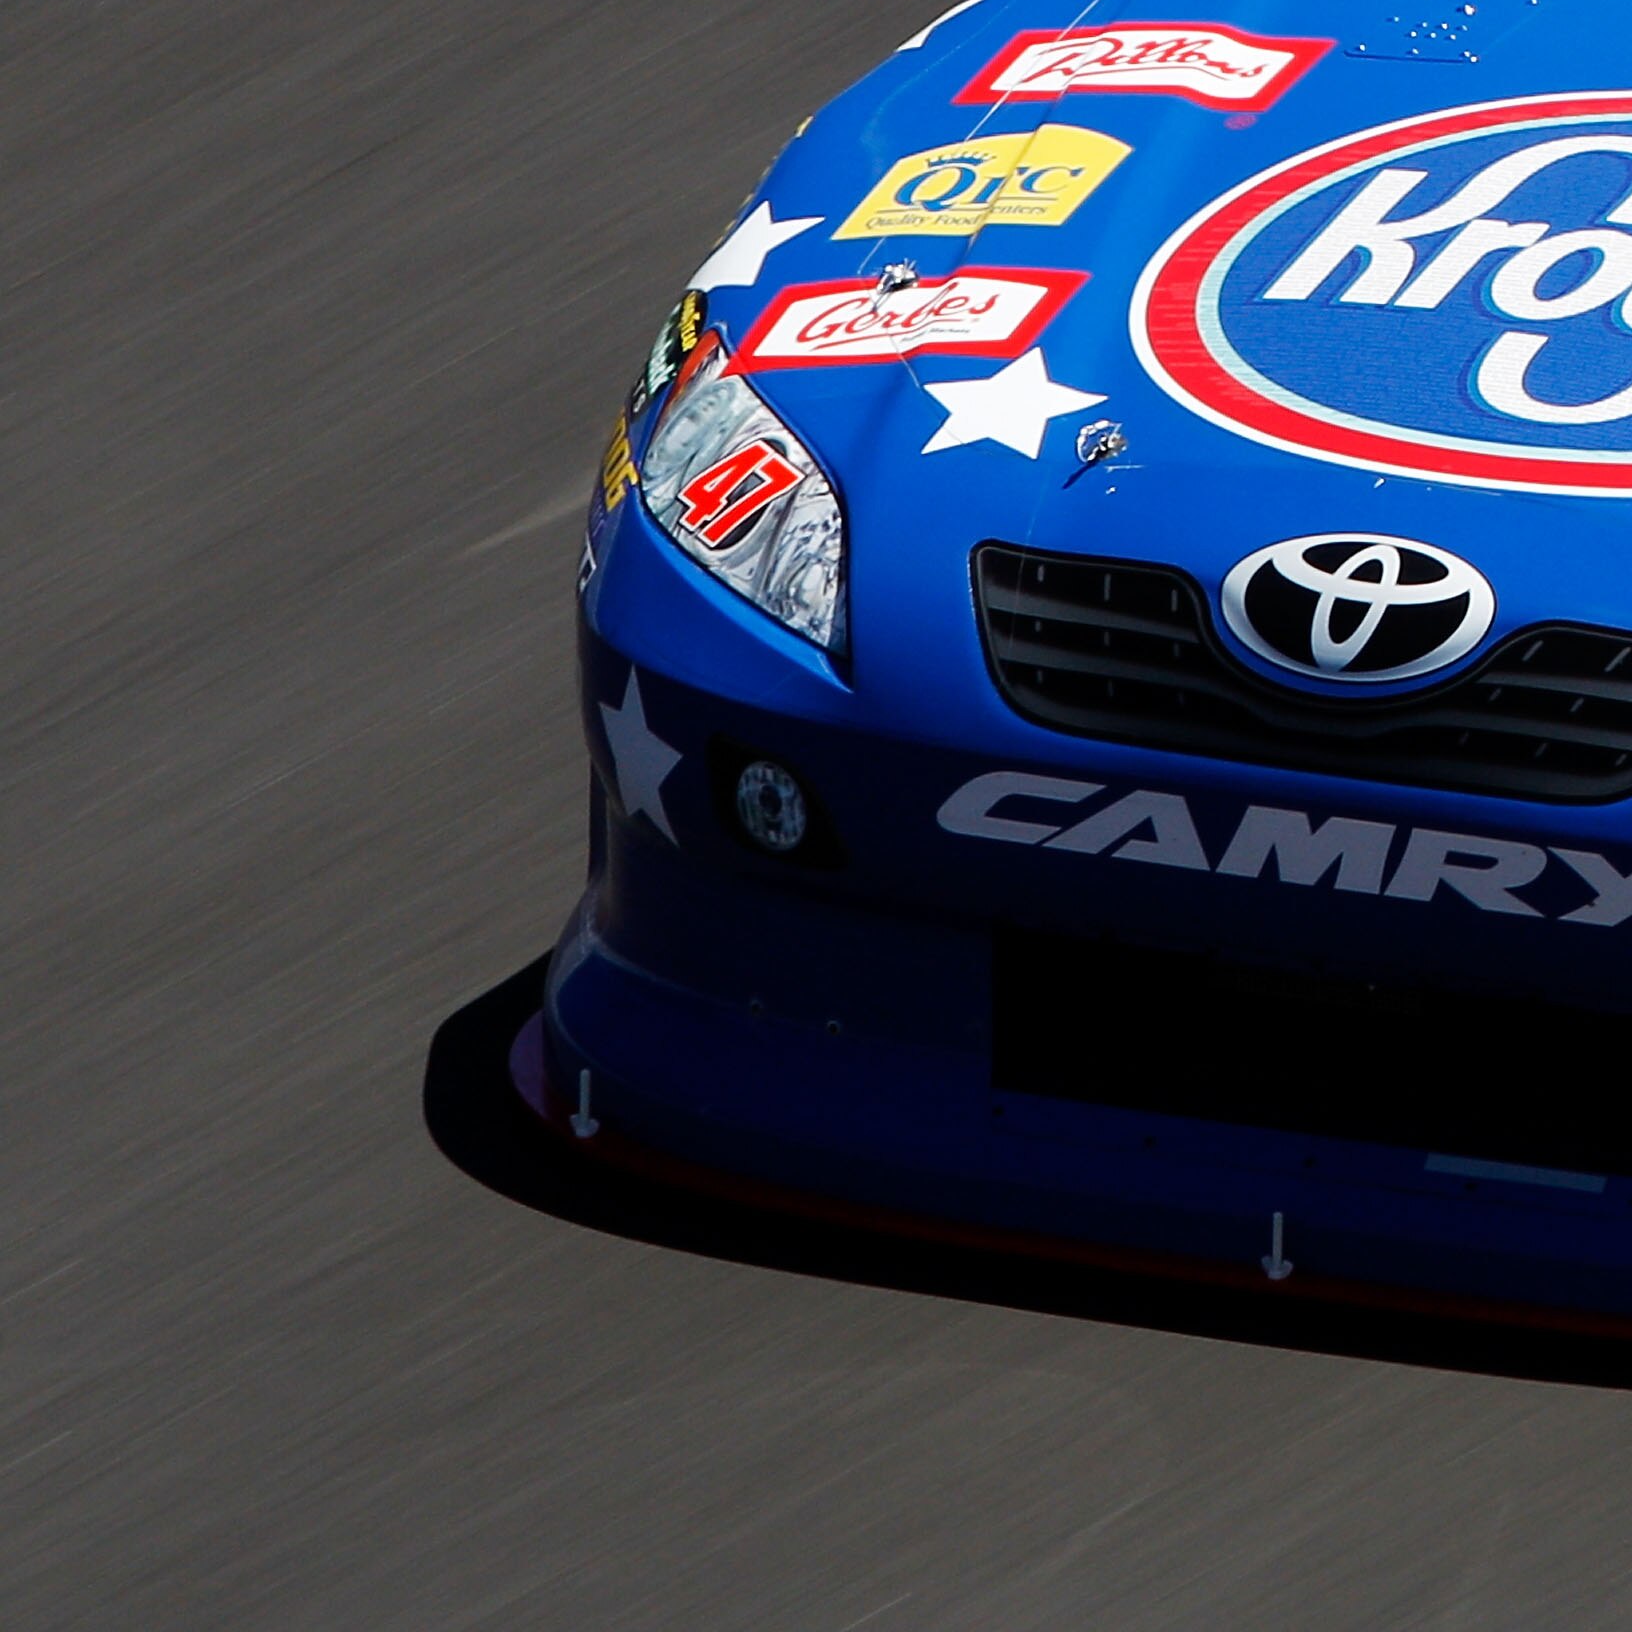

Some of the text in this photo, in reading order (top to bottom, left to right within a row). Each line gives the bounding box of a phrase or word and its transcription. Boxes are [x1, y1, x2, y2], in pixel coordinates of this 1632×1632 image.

[1018, 35, 1265, 84] Dillons
[865, 210, 926, 231] Quality
[931, 213, 981, 228] Food
[796, 280, 1001, 344] Gerbes
[675, 436, 808, 552] 47
